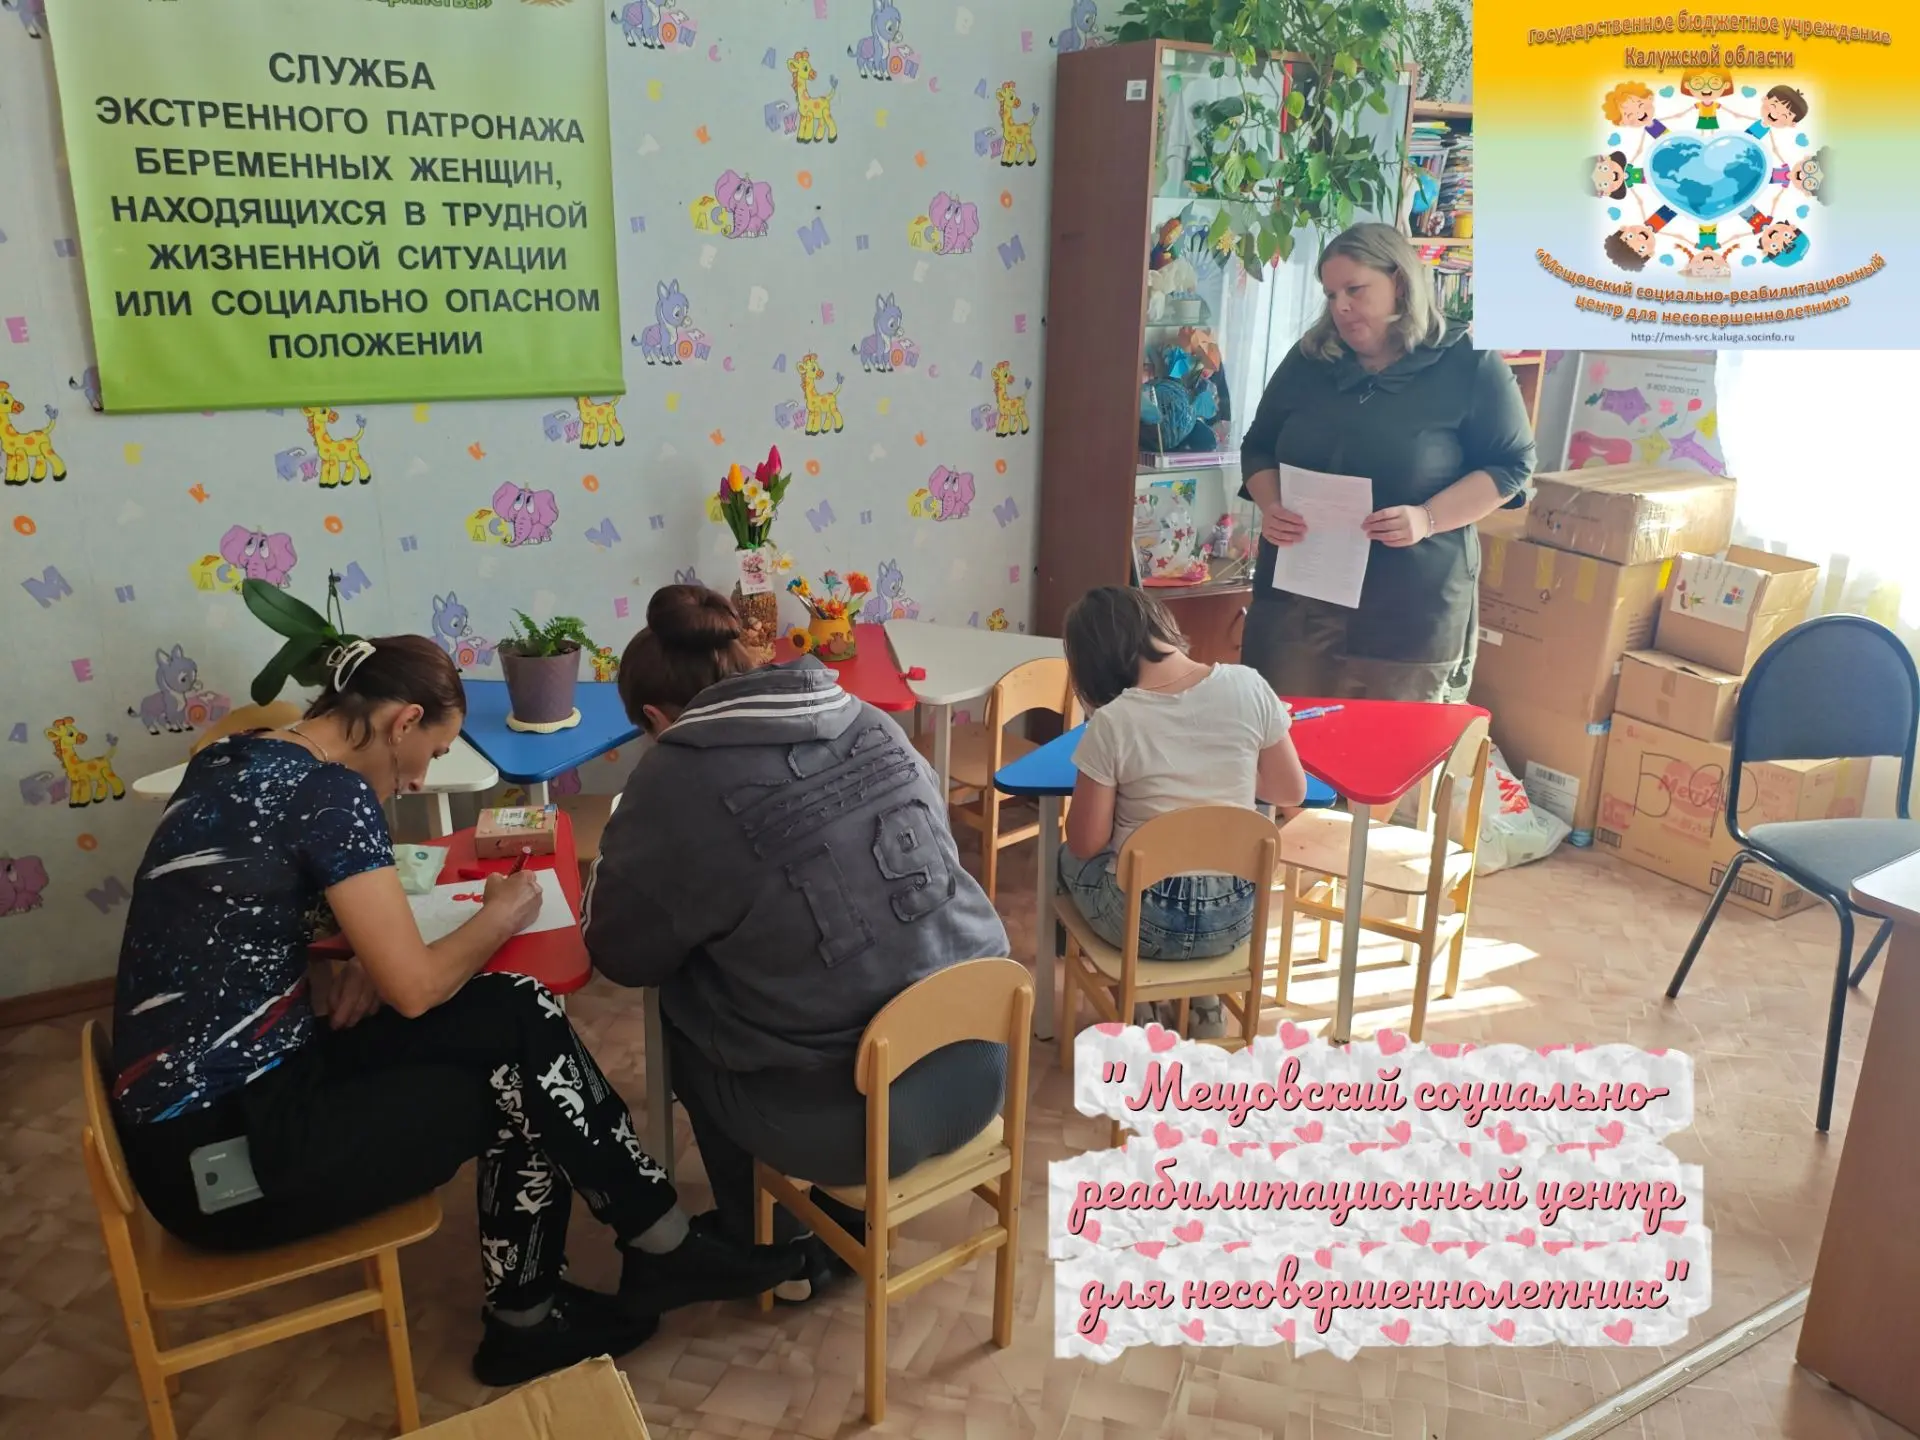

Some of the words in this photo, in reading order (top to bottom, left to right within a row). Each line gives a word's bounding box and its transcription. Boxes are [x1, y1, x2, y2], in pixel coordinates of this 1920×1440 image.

[268, 51, 436, 91] СЛУЖБА
[95, 95, 369, 135] ЭКСТРЕННОГО
[386, 109, 585, 144] ПАТРОНАЖА
[134, 146, 394, 182] БЕРЕМЕННЫХ
[408, 155, 563, 190] ЖЕНЩИН,
[110, 195, 387, 229] НАХОДЯЩИХСЯ
[404, 201, 427, 226] В
[441, 200, 588, 232] ТРУДНОЙ
[146, 240, 380, 271] ЖИЗНЕННОЙ
[397, 244, 567, 274] СИТУАЦИИ
[115, 290, 193, 317] ИЛИ
[211, 288, 428, 319] СОЦИАЛЬНО
[445, 288, 600, 313] ОПАСНОМ
[268, 331, 483, 359] ПОЛОЖЕНИИ
